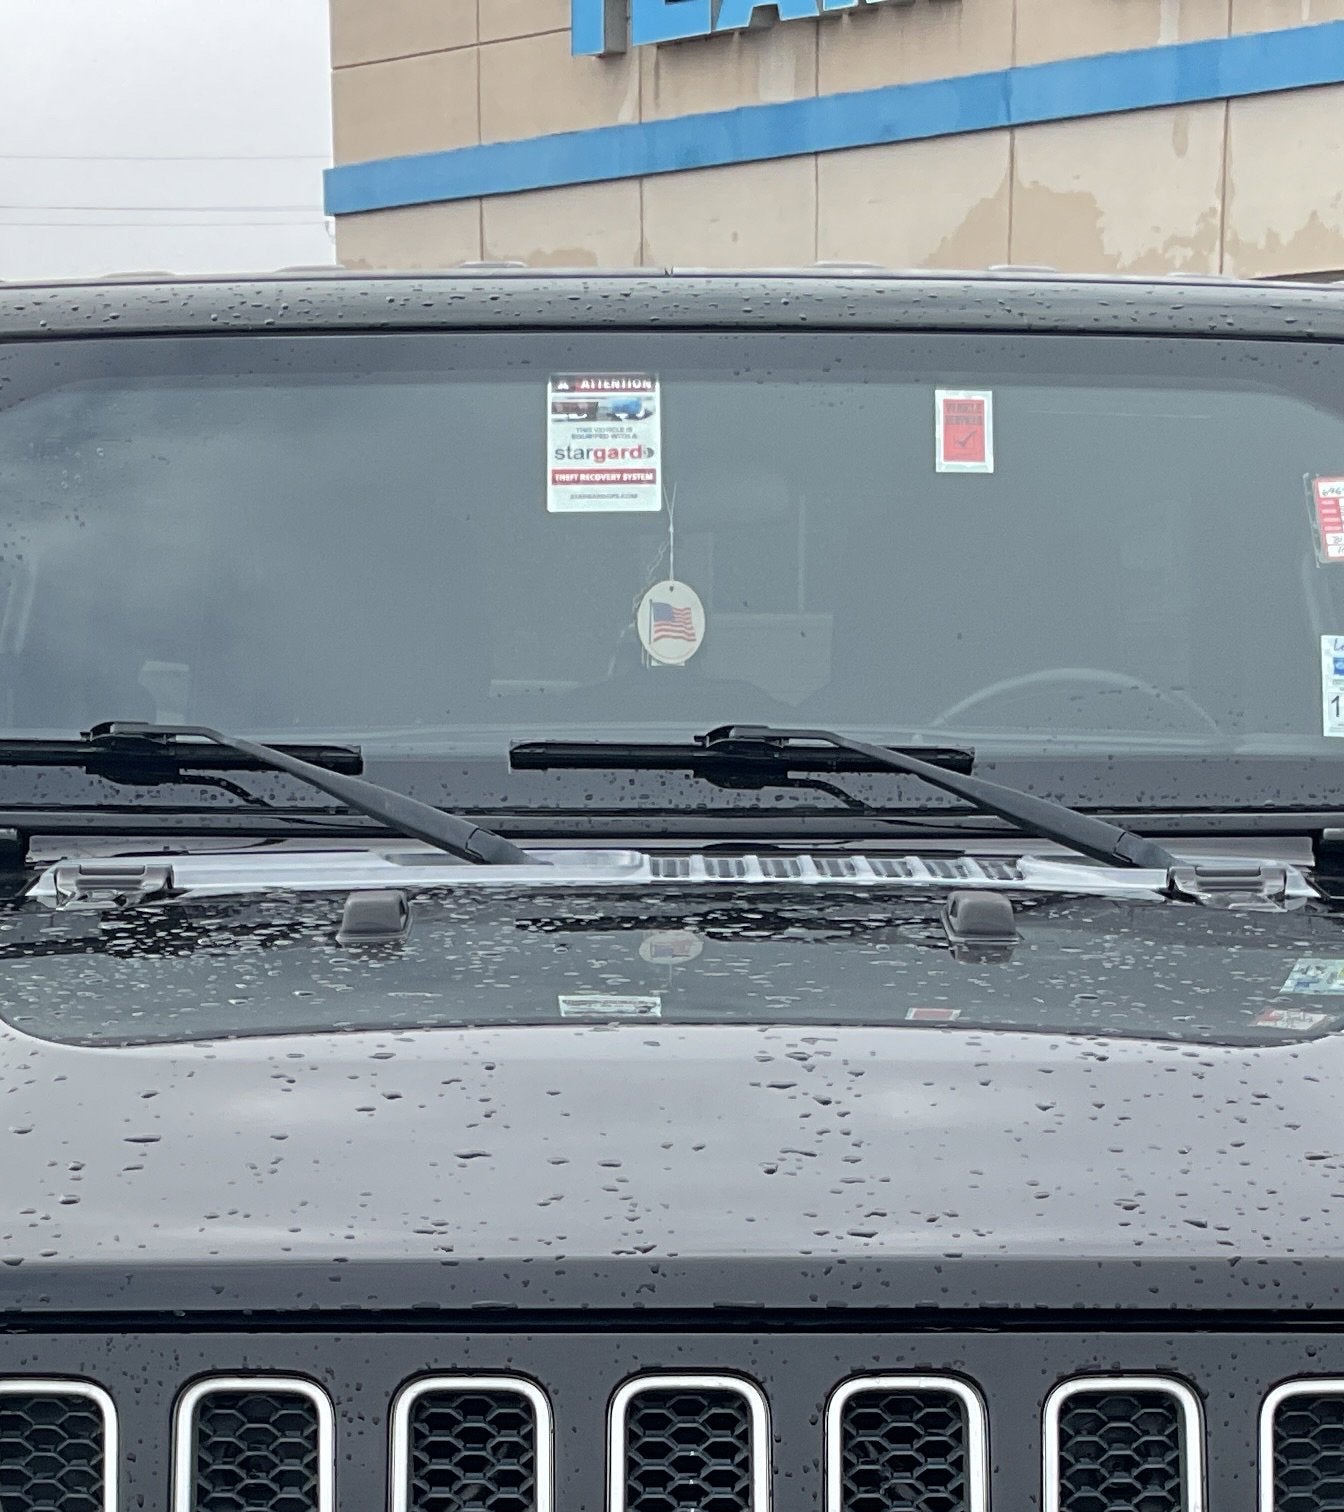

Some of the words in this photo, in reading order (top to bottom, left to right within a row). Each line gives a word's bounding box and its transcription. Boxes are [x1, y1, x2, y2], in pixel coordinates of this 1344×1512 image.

[580, 379, 652, 389] ATTENTION
[554, 445, 642, 464] stargard
[554, 473, 578, 481] THEFT
[580, 473, 621, 481] RECOVERY
[623, 473, 654, 481] SYSTEM
